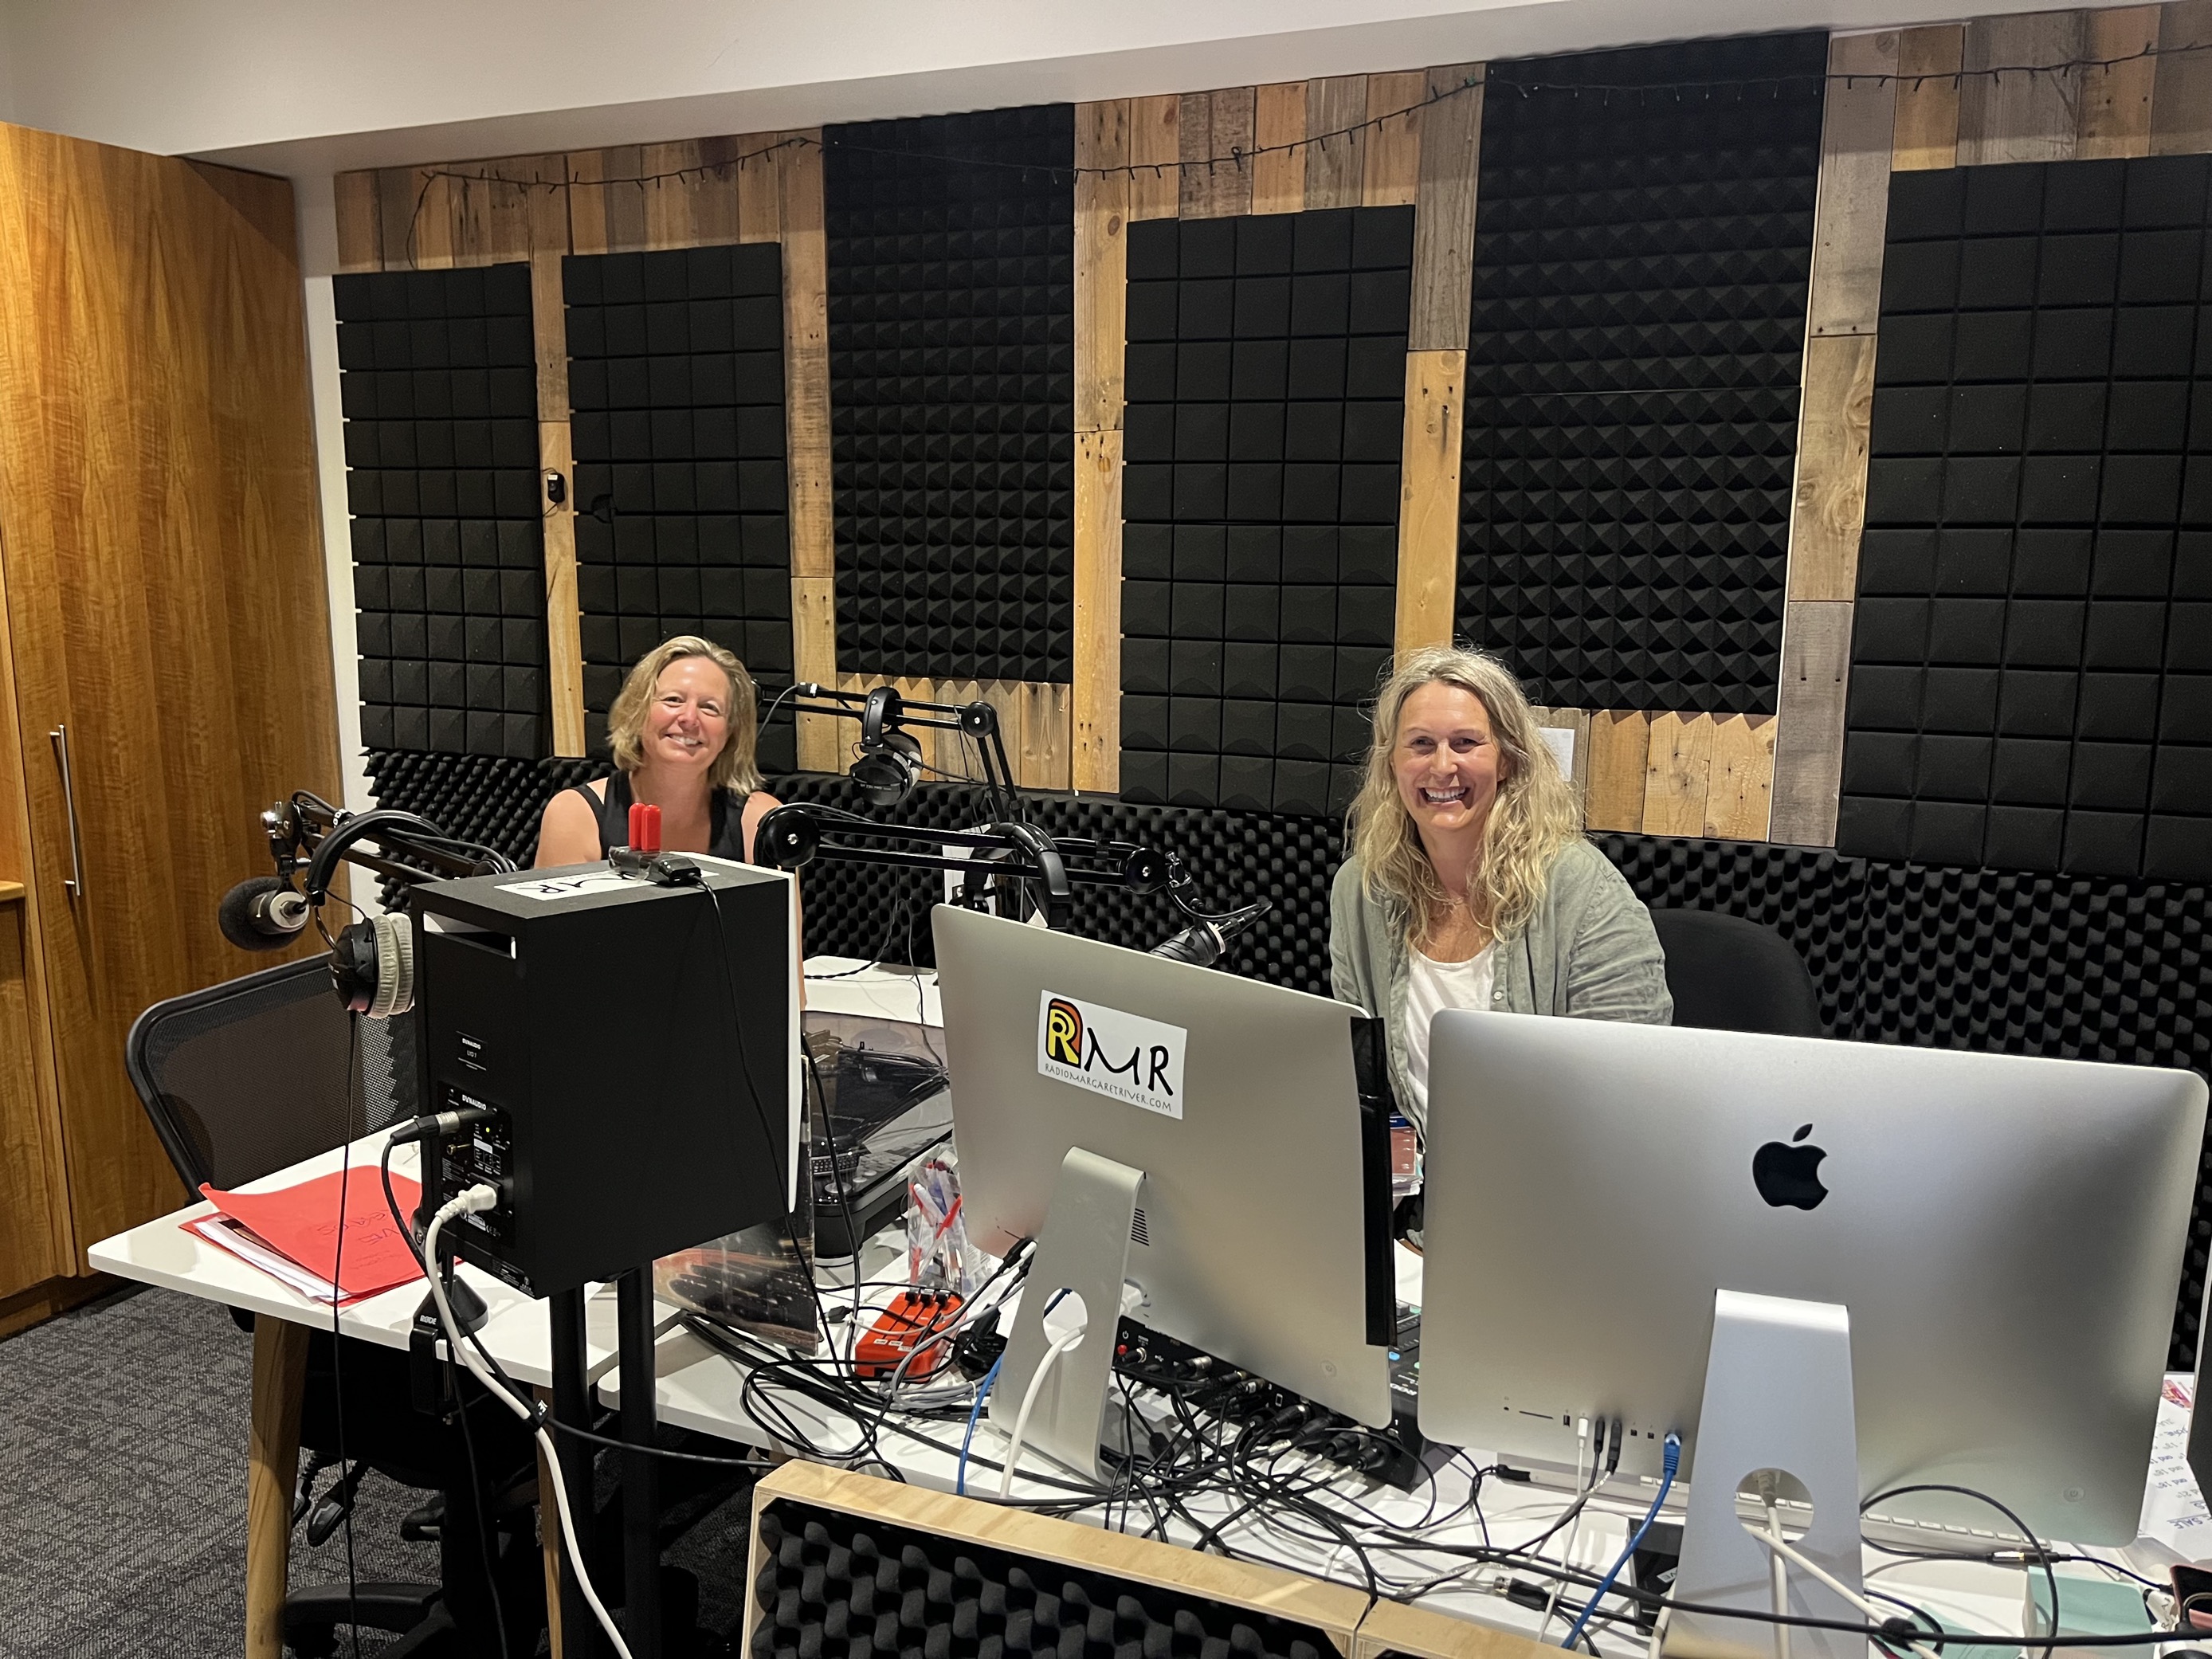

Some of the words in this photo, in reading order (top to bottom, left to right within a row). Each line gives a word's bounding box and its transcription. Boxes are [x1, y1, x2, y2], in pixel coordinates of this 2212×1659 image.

[461, 1037, 481, 1049] DYNAUDIO
[1045, 1063, 1172, 1112] RADIOMARGARETRIVER.COM
[461, 1094, 487, 1111] DYNAUDIO
